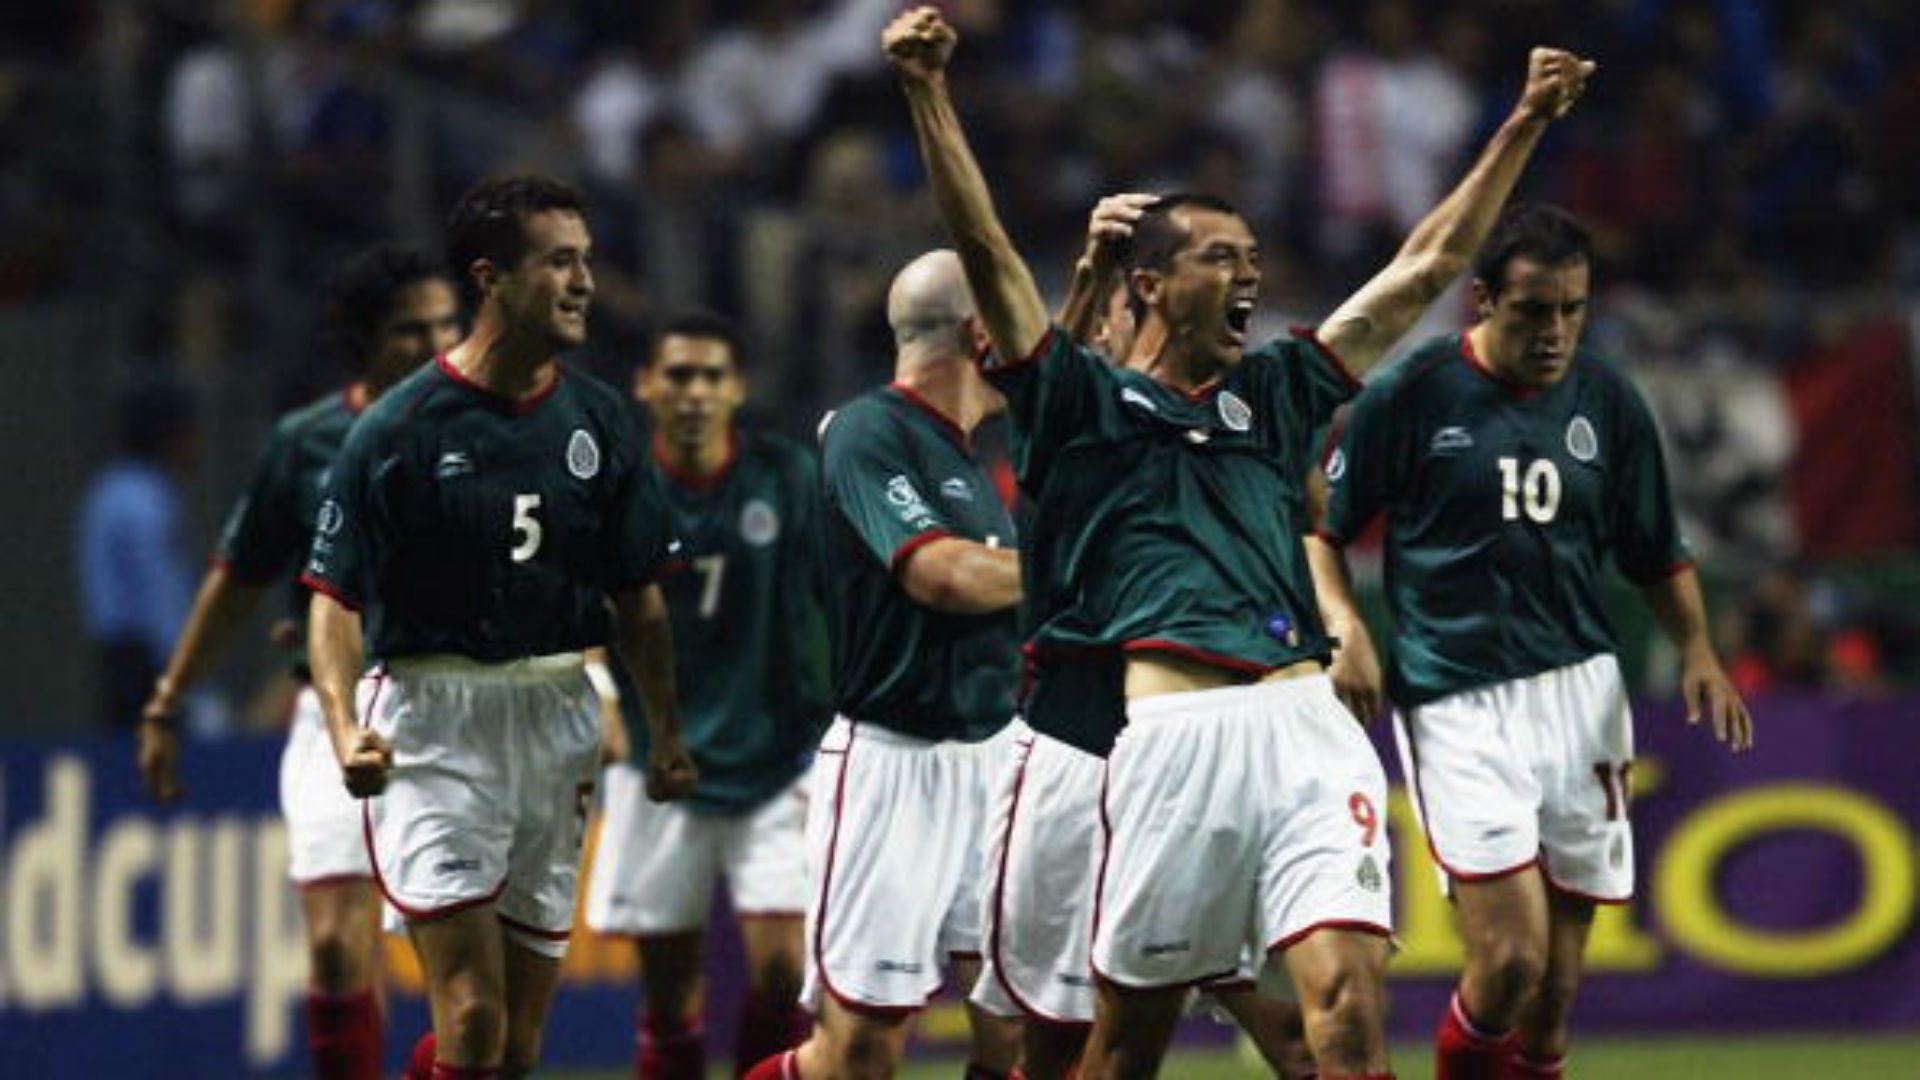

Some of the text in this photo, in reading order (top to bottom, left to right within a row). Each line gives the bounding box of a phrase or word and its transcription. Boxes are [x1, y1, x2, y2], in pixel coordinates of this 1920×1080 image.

[1498, 458, 1561, 523] 10
[511, 494, 541, 562] 5
[693, 555, 725, 616] 7
[1349, 792, 1376, 847] 9
[0, 755, 308, 1065] dcup
